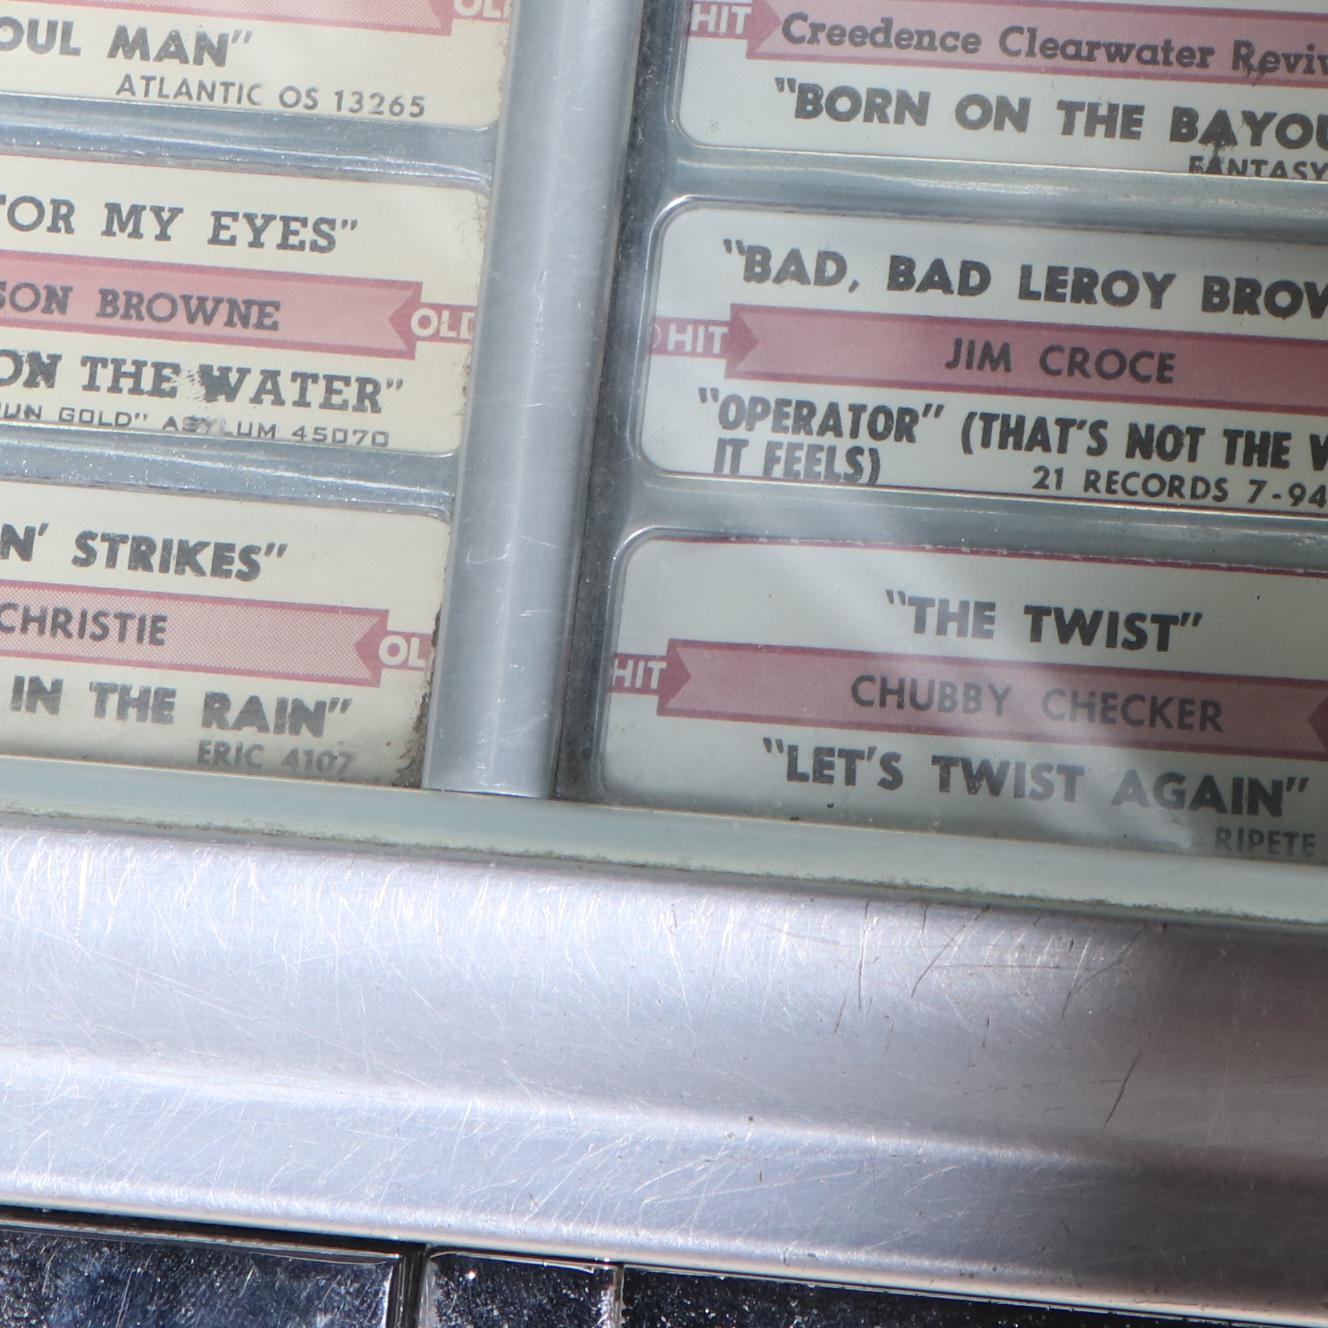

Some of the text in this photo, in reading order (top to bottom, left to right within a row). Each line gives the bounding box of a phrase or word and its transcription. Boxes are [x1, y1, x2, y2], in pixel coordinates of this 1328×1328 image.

[107, 25, 252, 68] MAN"
[780, 12, 982, 55] Creedence
[999, 26, 1216, 70] Clearwater
[116, 73, 426, 118] ATLANTIC OS 13265
[100, 202, 185, 243] MY
[208, 210, 358, 254] EYES"
[96, 288, 282, 332] BROWNE
[945, 338, 1176, 384] JIM CROCE
[1032, 464, 1064, 492] 21
[1082, 470, 1230, 505] RECORDS
[72, 531, 288, 582] STRIKES"
[886, 589, 1203, 653] "THE TWIST"
[849, 673, 1226, 734] CHUBBY CHECKER
[195, 740, 356, 774] ERIC 4107
